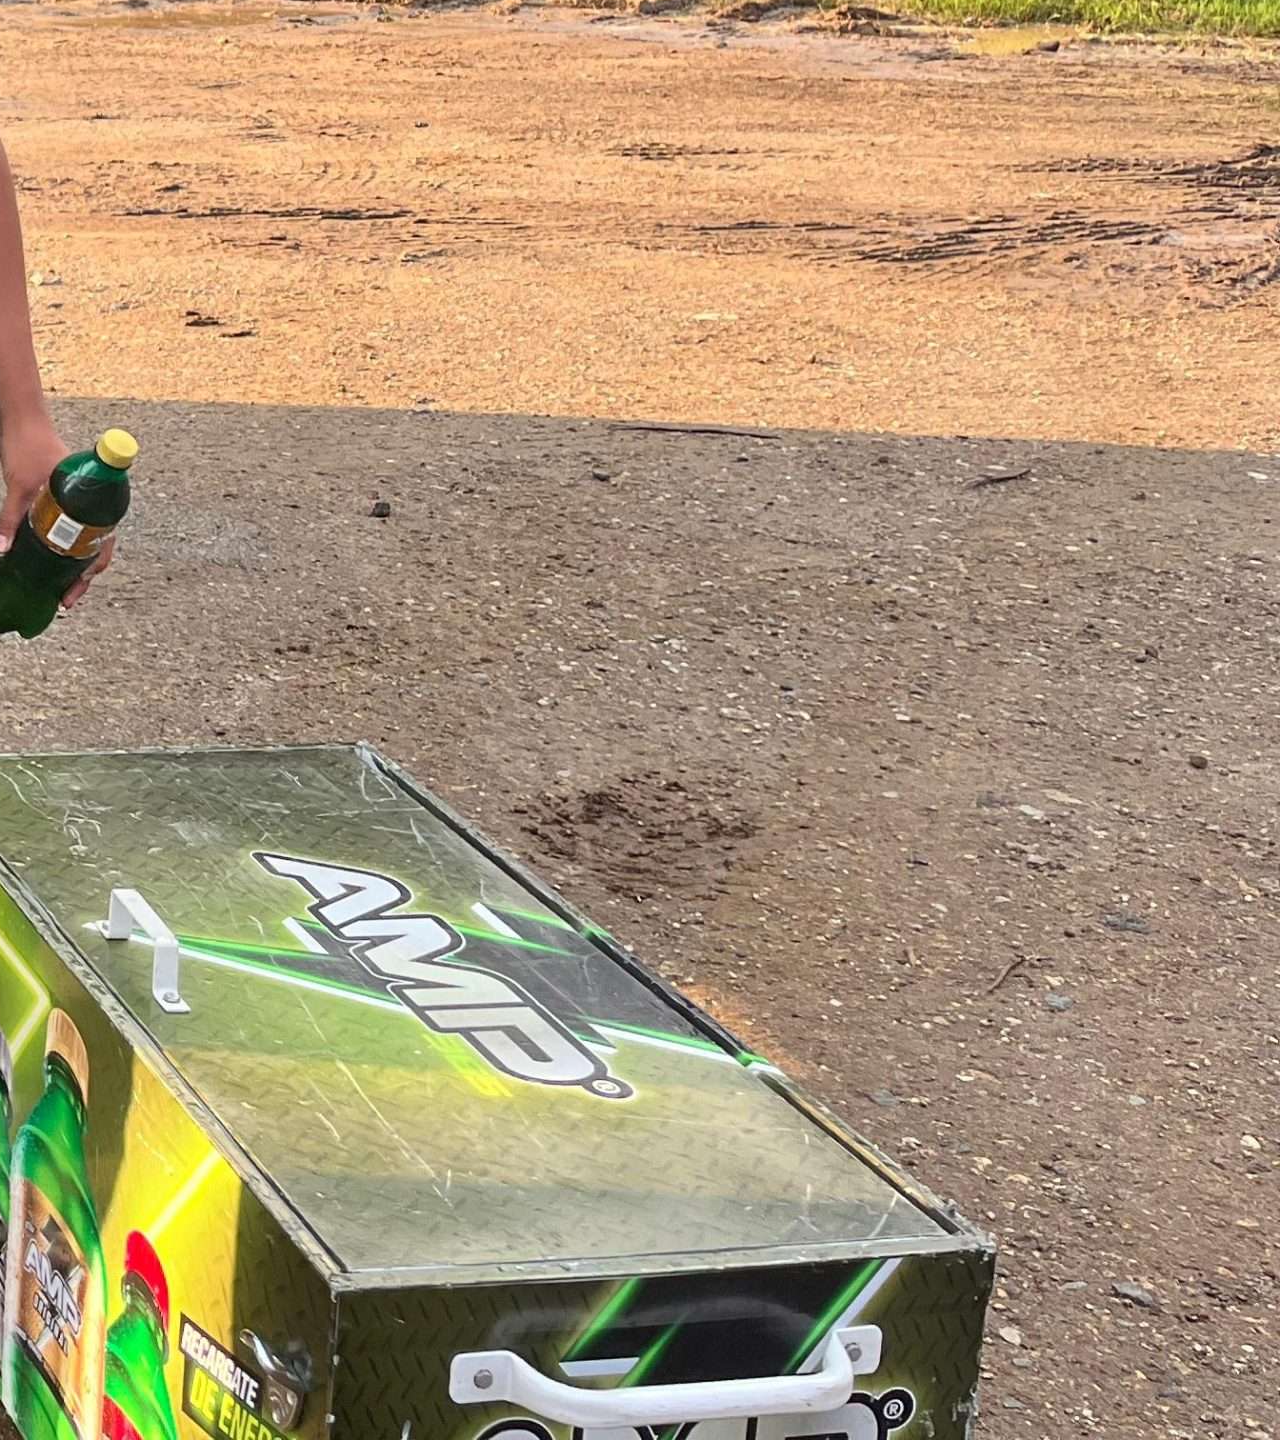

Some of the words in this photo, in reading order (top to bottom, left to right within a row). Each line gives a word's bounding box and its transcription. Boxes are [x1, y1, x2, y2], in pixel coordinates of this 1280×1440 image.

[251, 851, 612, 1087] AMP
[23, 1238, 82, 1335] AMP
[181, 1322, 259, 1409] RECARGATE
[190, 1367, 220, 1422] DE
